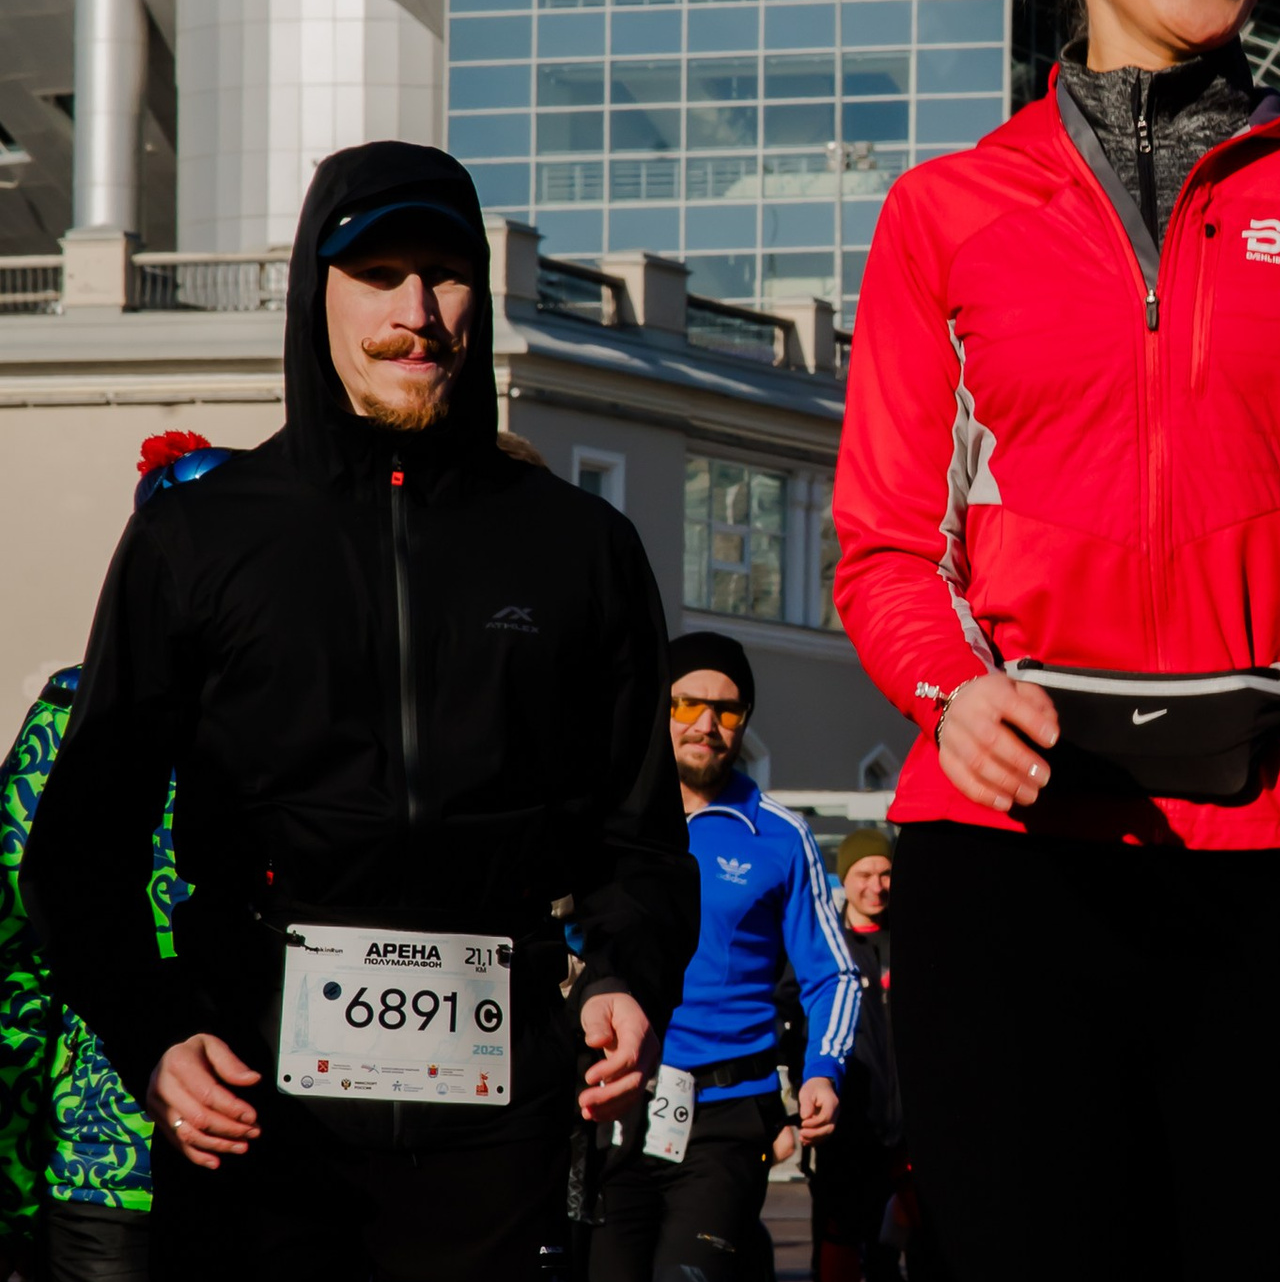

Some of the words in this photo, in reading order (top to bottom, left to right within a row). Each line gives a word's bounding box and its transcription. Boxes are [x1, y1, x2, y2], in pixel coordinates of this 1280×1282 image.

[366, 942, 442, 961] АРЕНА
[464, 947, 493, 968] 21,1
[363, 957, 442, 969] ПОЛУМАРАФОН
[344, 987, 458, 1033] 6891
[472, 1044, 504, 1057] 2025
